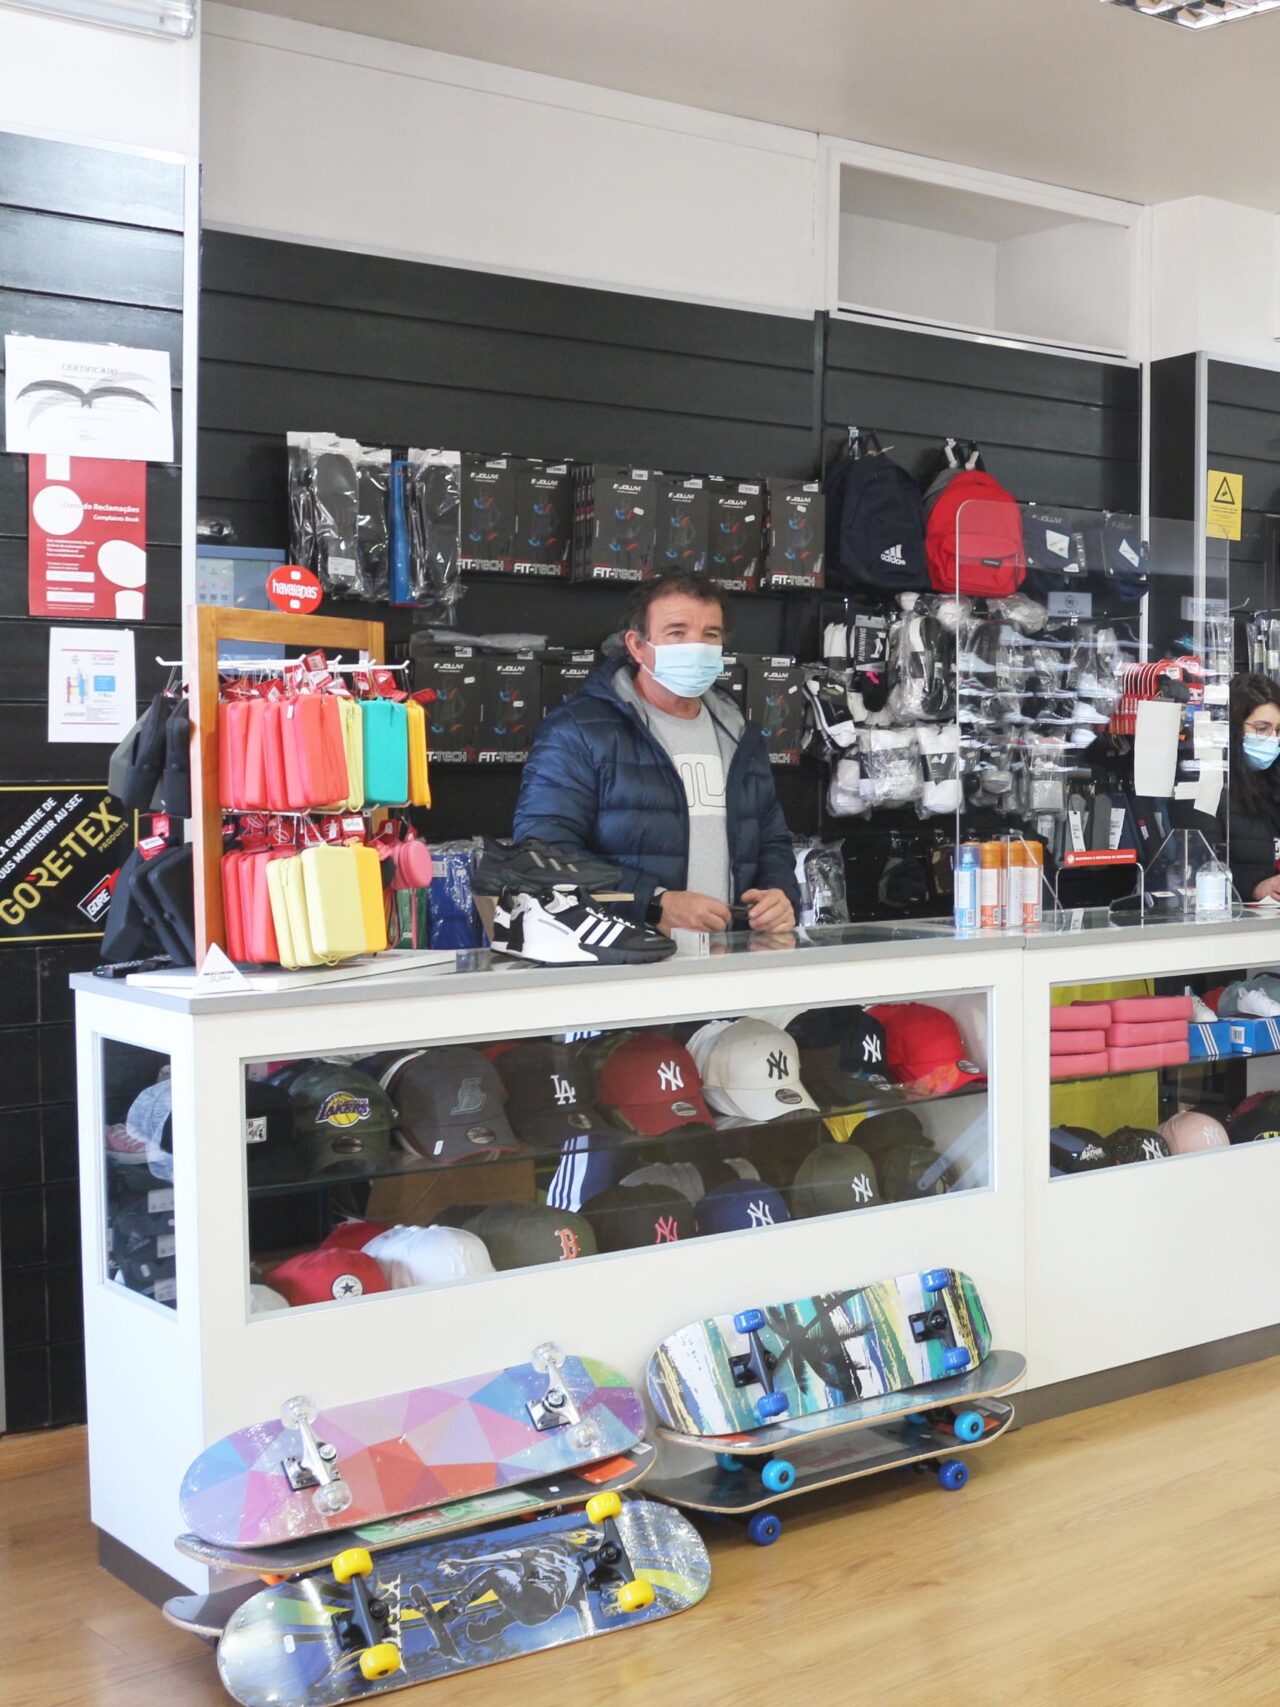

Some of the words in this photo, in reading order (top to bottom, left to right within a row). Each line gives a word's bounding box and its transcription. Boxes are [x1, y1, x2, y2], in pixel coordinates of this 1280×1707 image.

[61, 363, 119, 376] CERTIFICADO
[513, 562, 562, 576] FIT-TECH
[592, 566, 643, 582] FIT-TECH
[880, 553, 906, 566] adidas
[771, 574, 816, 588] FIT-TECH
[857, 626, 867, 662] RUNNING
[5, 806, 45, 848] GARANTIE
[41, 796, 57, 812] DE
[14, 819, 58, 863] MAINTENIR
[54, 807, 70, 823] AU
[65, 793, 83, 812] SEC
[98, 820, 130, 853] PRODUITS
[86, 887, 112, 918] GORE
[863, 1033, 881, 1063] NY
[657, 1060, 685, 1092] NY
[766, 1048, 790, 1081] NY
[550, 1074, 577, 1105] LA
[851, 1173, 873, 1203] NY
[746, 1200, 775, 1228] NY
[554, 1227, 581, 1260] B
[655, 1215, 679, 1244] NY
